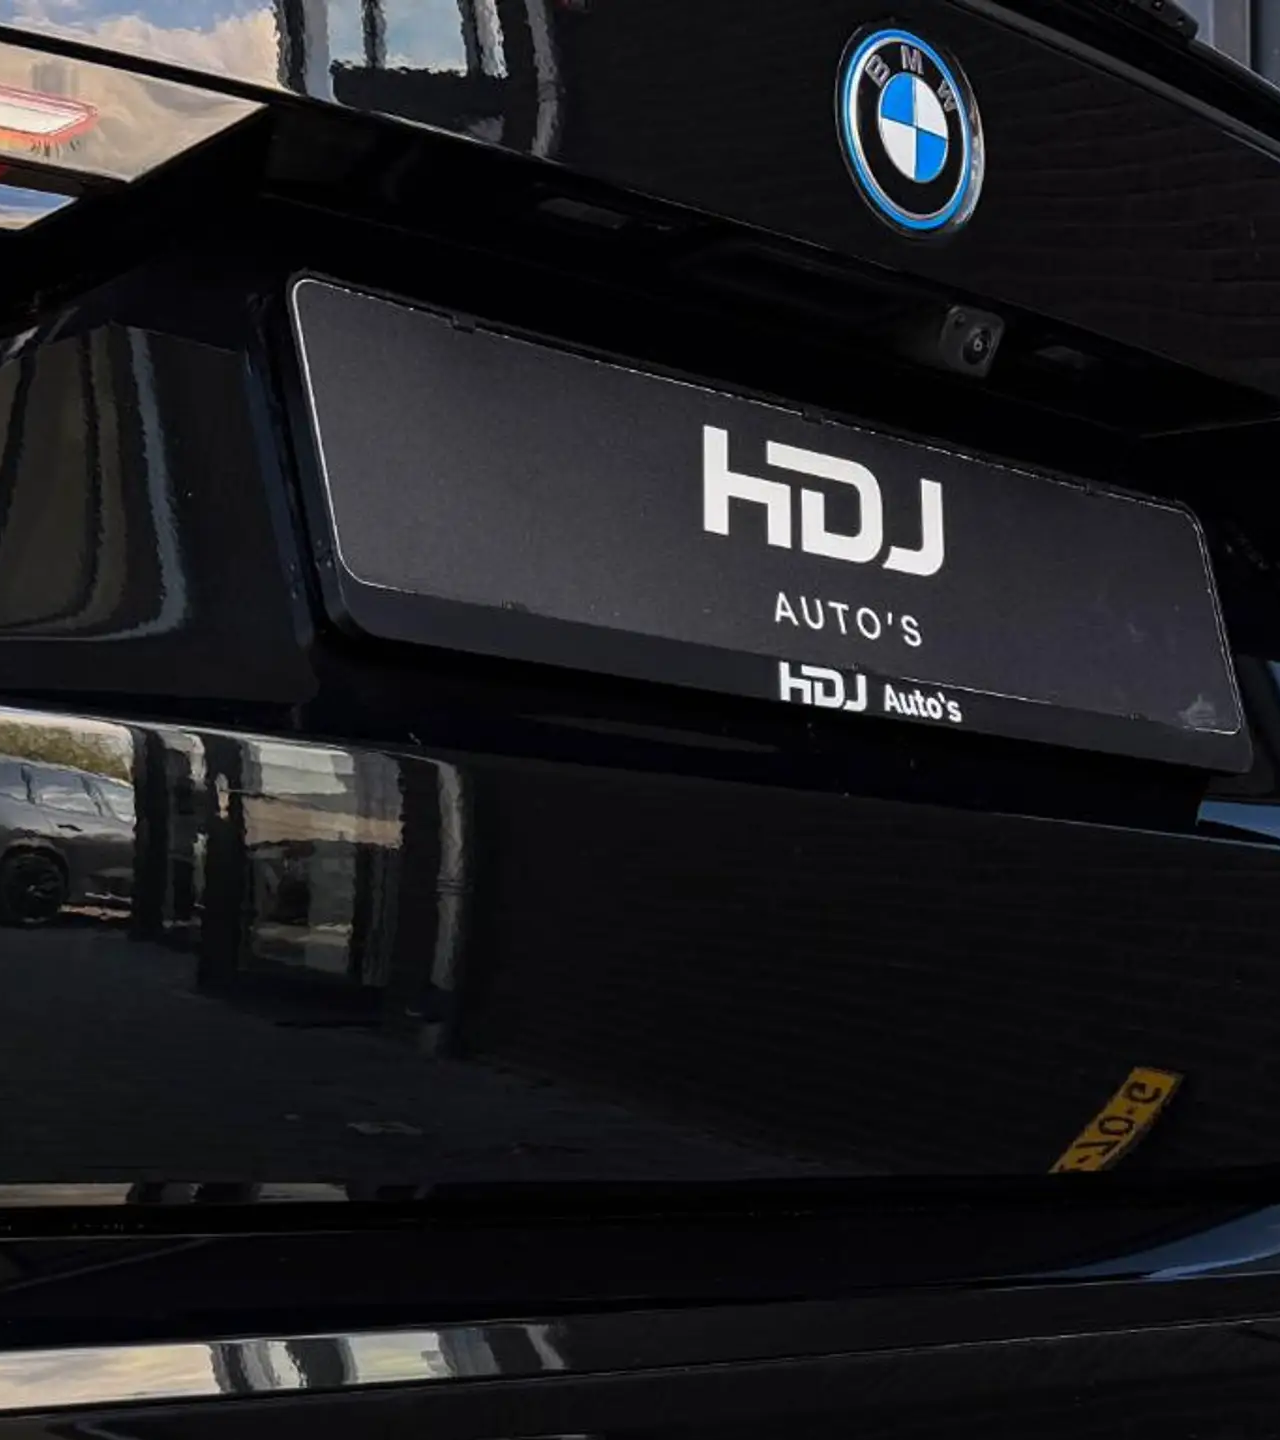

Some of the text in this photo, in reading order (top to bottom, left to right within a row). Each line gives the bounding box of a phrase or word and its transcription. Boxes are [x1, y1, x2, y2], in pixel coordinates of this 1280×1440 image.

[865, 45, 958, 113] BMW
[703, 425, 944, 577] HDJ
[775, 591, 923, 648] AUTO'S
[779, 661, 963, 723] HDJ Auto's
